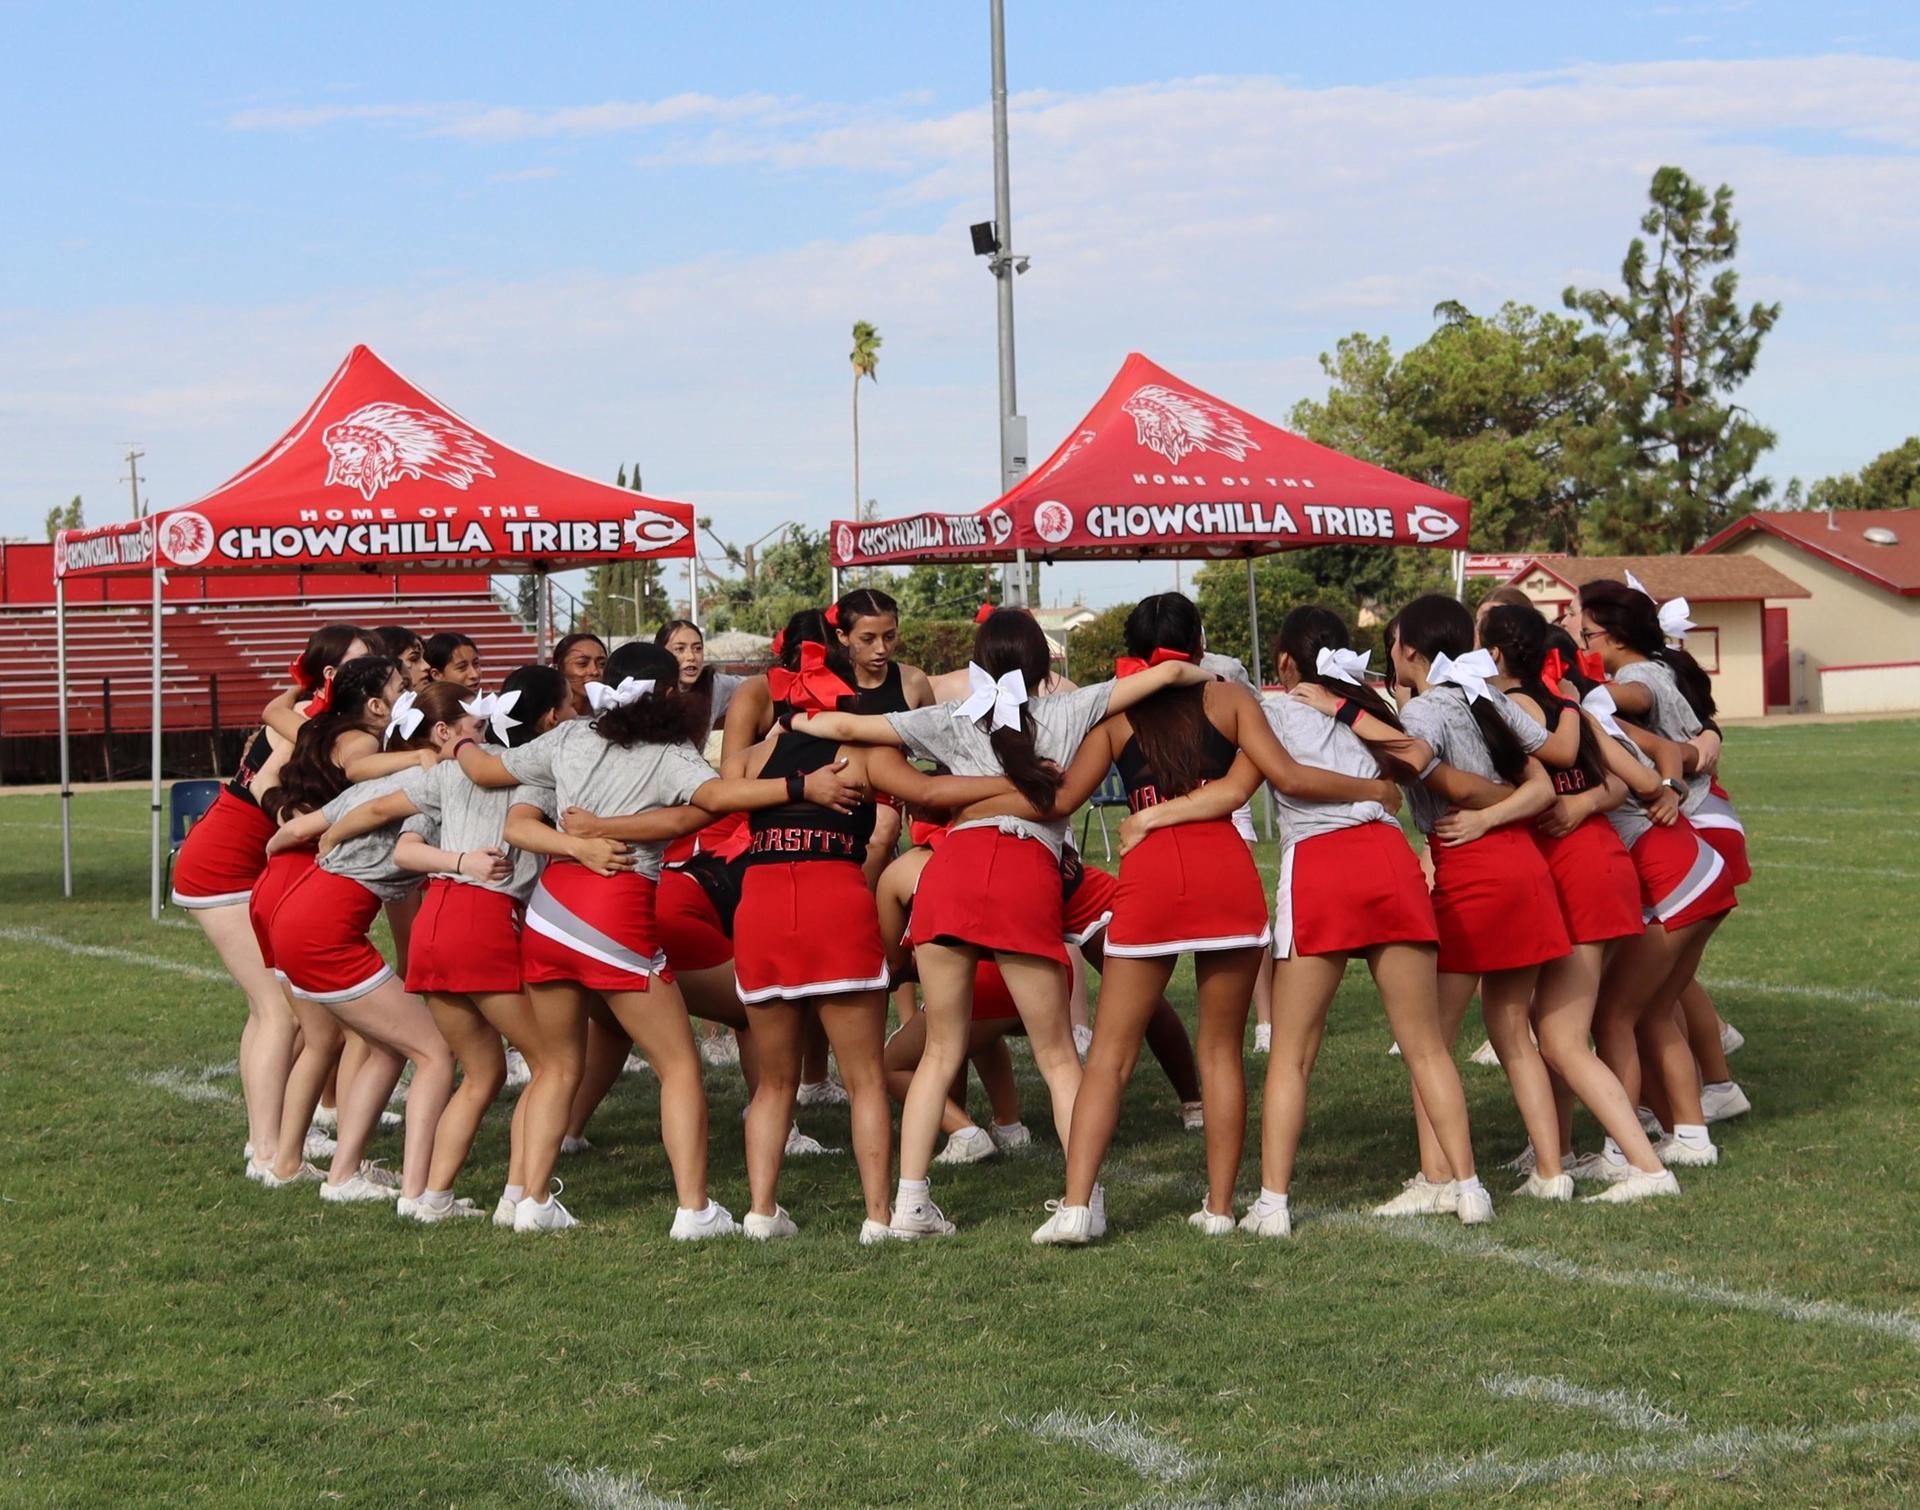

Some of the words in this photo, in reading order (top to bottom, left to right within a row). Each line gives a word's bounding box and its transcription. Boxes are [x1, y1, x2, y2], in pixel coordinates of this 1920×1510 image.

[1133, 473, 1206, 486] HOME
[1222, 476, 1250, 487] OF
[1265, 477, 1315, 488] THE
[300, 508, 397, 521] HOME
[418, 506, 458, 518] OF
[478, 506, 541, 518] THE
[1086, 502, 1298, 538] CHOWCHILLA
[1303, 504, 1395, 539] TRIBE
[218, 521, 495, 559] CHOWCHILLA
[504, 520, 622, 553] TRIBE
[857, 517, 944, 557] CHOWCHILLA
[944, 515, 988, 546] TRIBE
[750, 827, 854, 854] ARSITY
